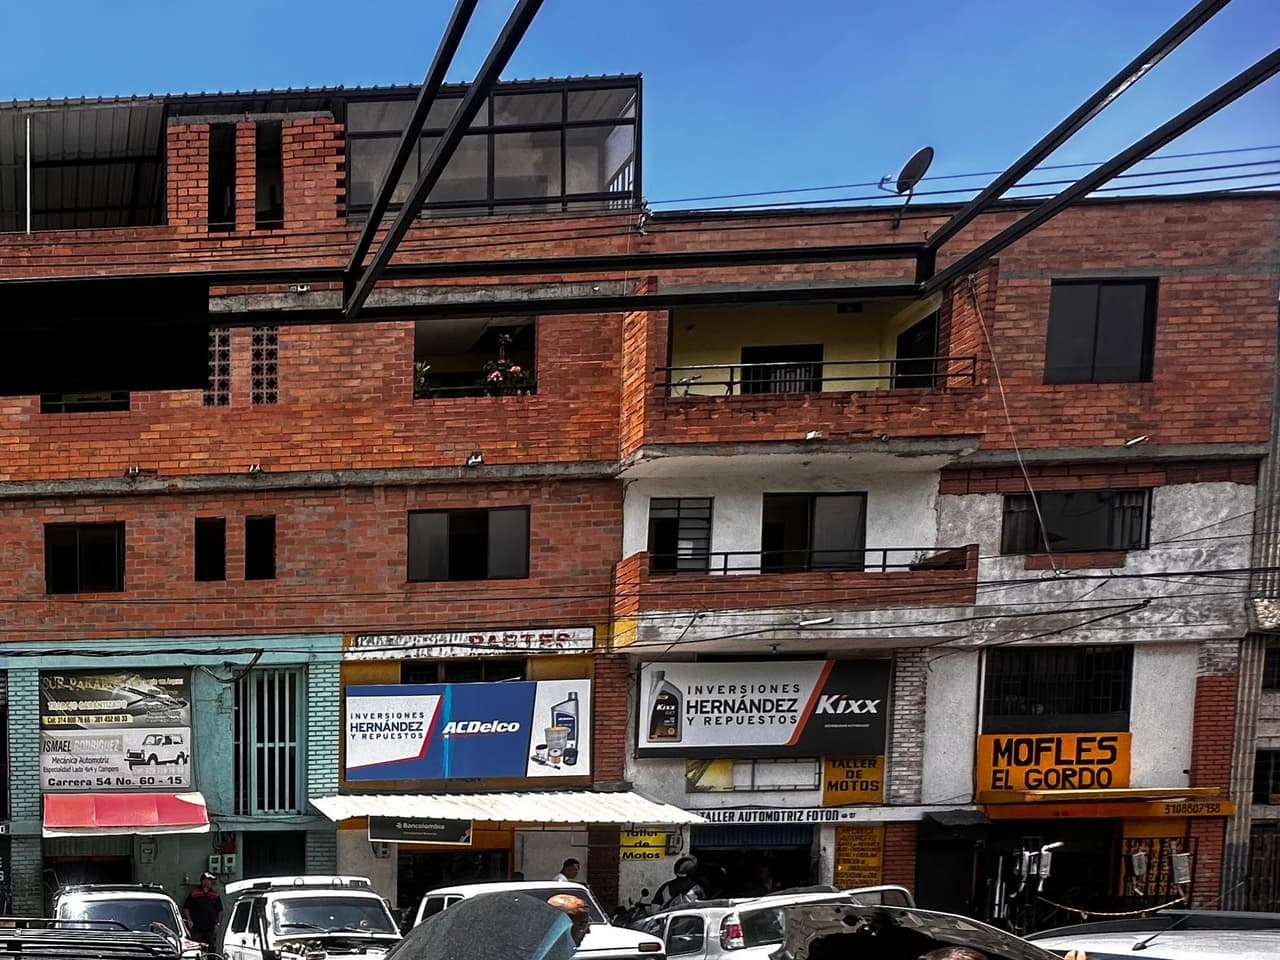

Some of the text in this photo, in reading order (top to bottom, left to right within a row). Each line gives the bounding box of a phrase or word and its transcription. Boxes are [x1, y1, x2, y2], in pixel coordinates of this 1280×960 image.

[687, 684, 800, 695] INVERSIONES
[686, 695, 797, 714] HERNÁNDEZ
[815, 694, 880, 714] Kixx
[350, 712, 425, 720] INVERSIONES
[686, 716, 693, 726] Y
[704, 715, 797, 726] REPUESTOS
[350, 720, 423, 732] HERNÁNDEZ
[441, 720, 520, 734] ACDelco
[43, 740, 72, 752] ISMAEL
[992, 736, 1118, 767] MOFLES
[831, 759, 877, 769] TALLER
[845, 770, 863, 779] DE
[991, 767, 1113, 790] EL GORDO
[48, 778, 92, 786] Carrera
[96, 777, 111, 785] 54
[116, 777, 135, 785] No.
[139, 776, 155, 785] 60
[167, 776, 183, 785] 15
[826, 780, 880, 792] MOTOS
[700, 811, 735, 822] TALLER
[737, 810, 804, 822] AUTOMOTRIZ
[806, 810, 839, 821] FOTON
[622, 851, 661, 859] Motos
